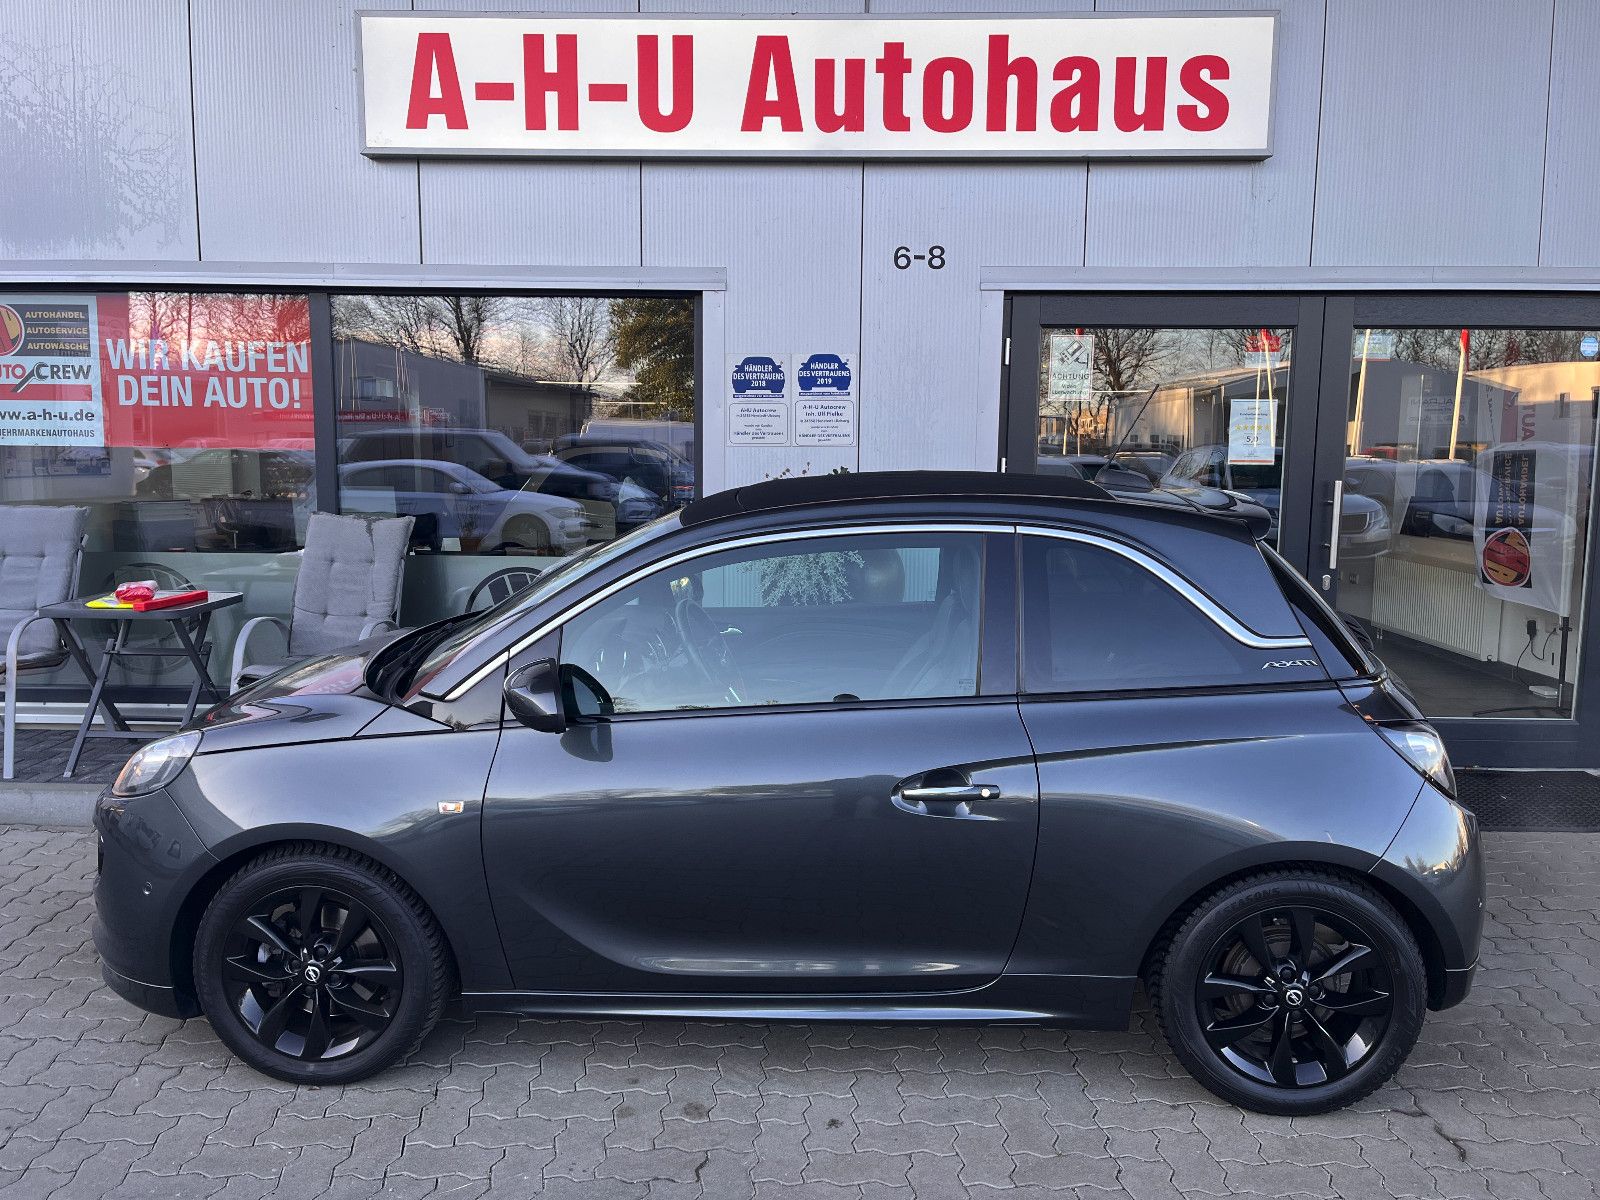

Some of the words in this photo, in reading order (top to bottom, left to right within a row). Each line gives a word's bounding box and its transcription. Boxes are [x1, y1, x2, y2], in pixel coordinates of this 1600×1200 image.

[406, 32, 694, 133] A-H-U
[740, 34, 1231, 133] Autohaus
[893, 245, 946, 270] 6-8
[25, 311, 85, 319] AUTOHANDEL
[26, 327, 88, 335] AUTOSERVICE
[106, 338, 170, 371] WIR
[180, 341, 309, 373] KAUFEN
[744, 363, 773, 372] HÄNDLER
[811, 361, 839, 370] HÄNDLER
[35, 362, 92, 380] CREW
[733, 372, 744, 380] DES
[745, 372, 784, 380] VERTRAUENS
[117, 375, 193, 407] DEIN
[203, 376, 301, 409] AUTO!
[0, 428, 95, 438] EHRMARKENAUTOHAUS
